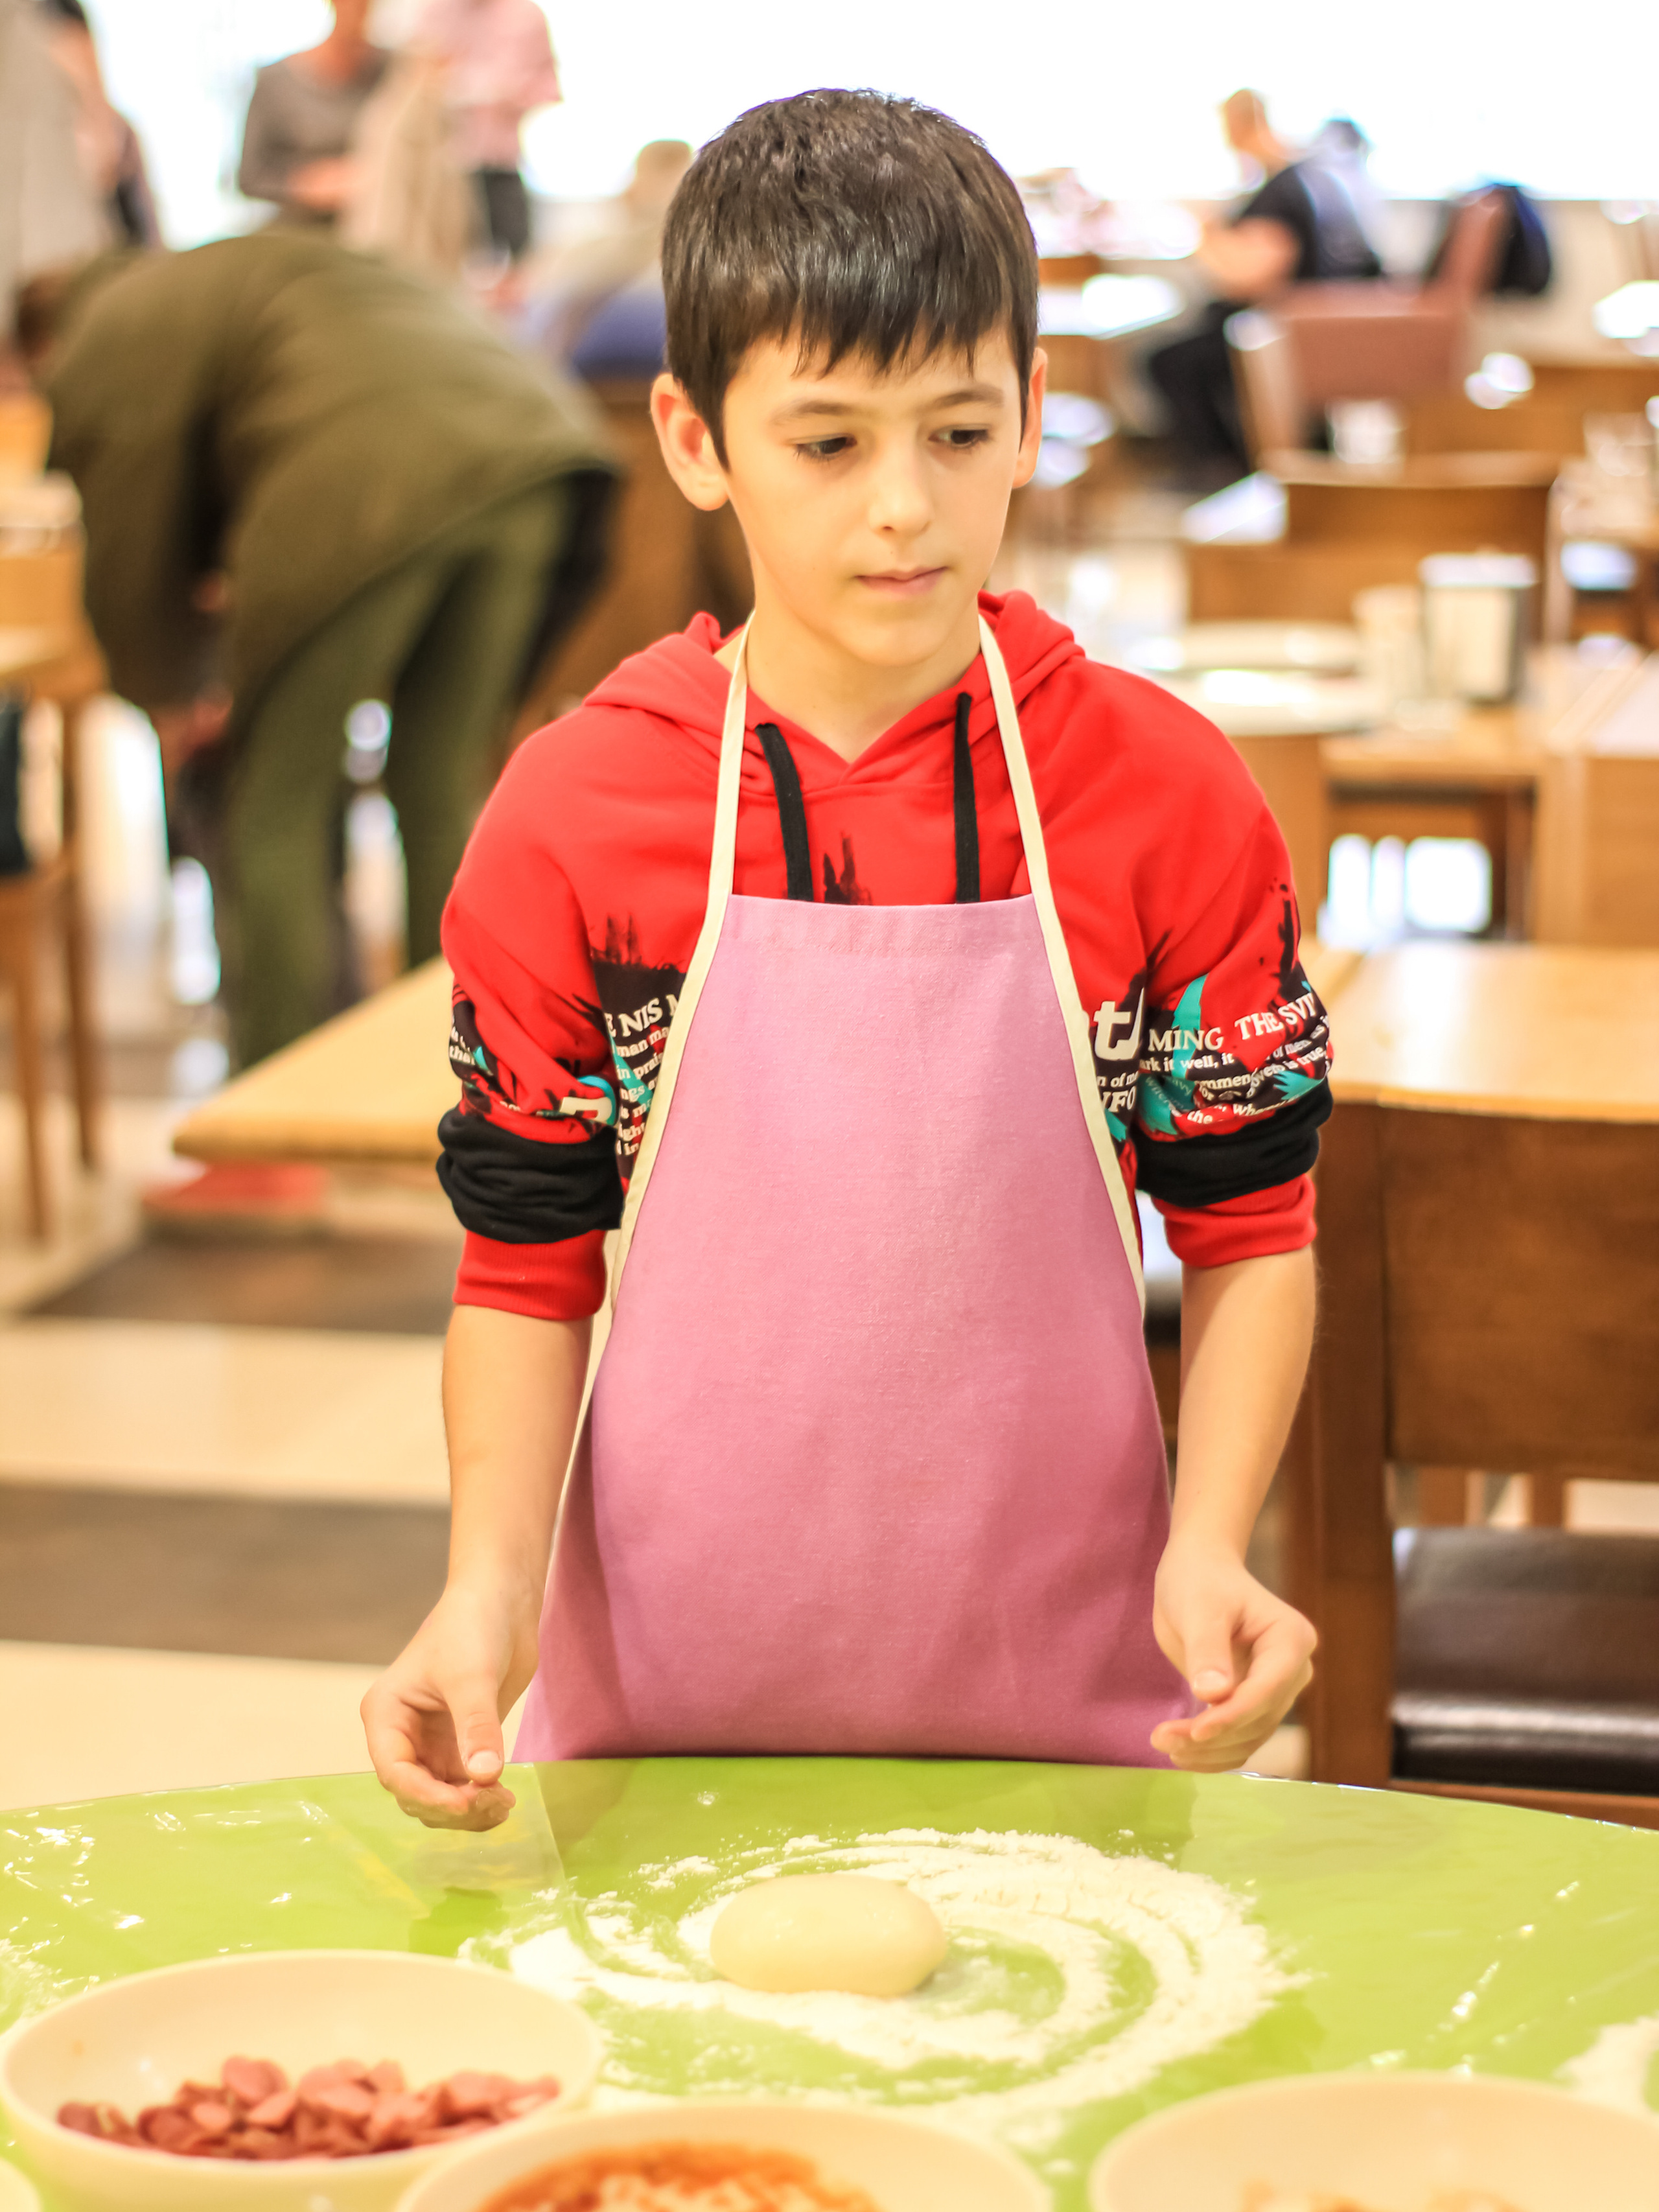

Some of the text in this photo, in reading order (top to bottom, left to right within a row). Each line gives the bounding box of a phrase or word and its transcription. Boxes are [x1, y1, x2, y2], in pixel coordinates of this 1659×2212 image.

[1235, 1012, 1284, 1040] THE
[1147, 1027, 1224, 1052] MING
[1180, 1055, 1219, 1069] well,
[1222, 1053, 1235, 1066] it
[1110, 1073, 1126, 1088] of
